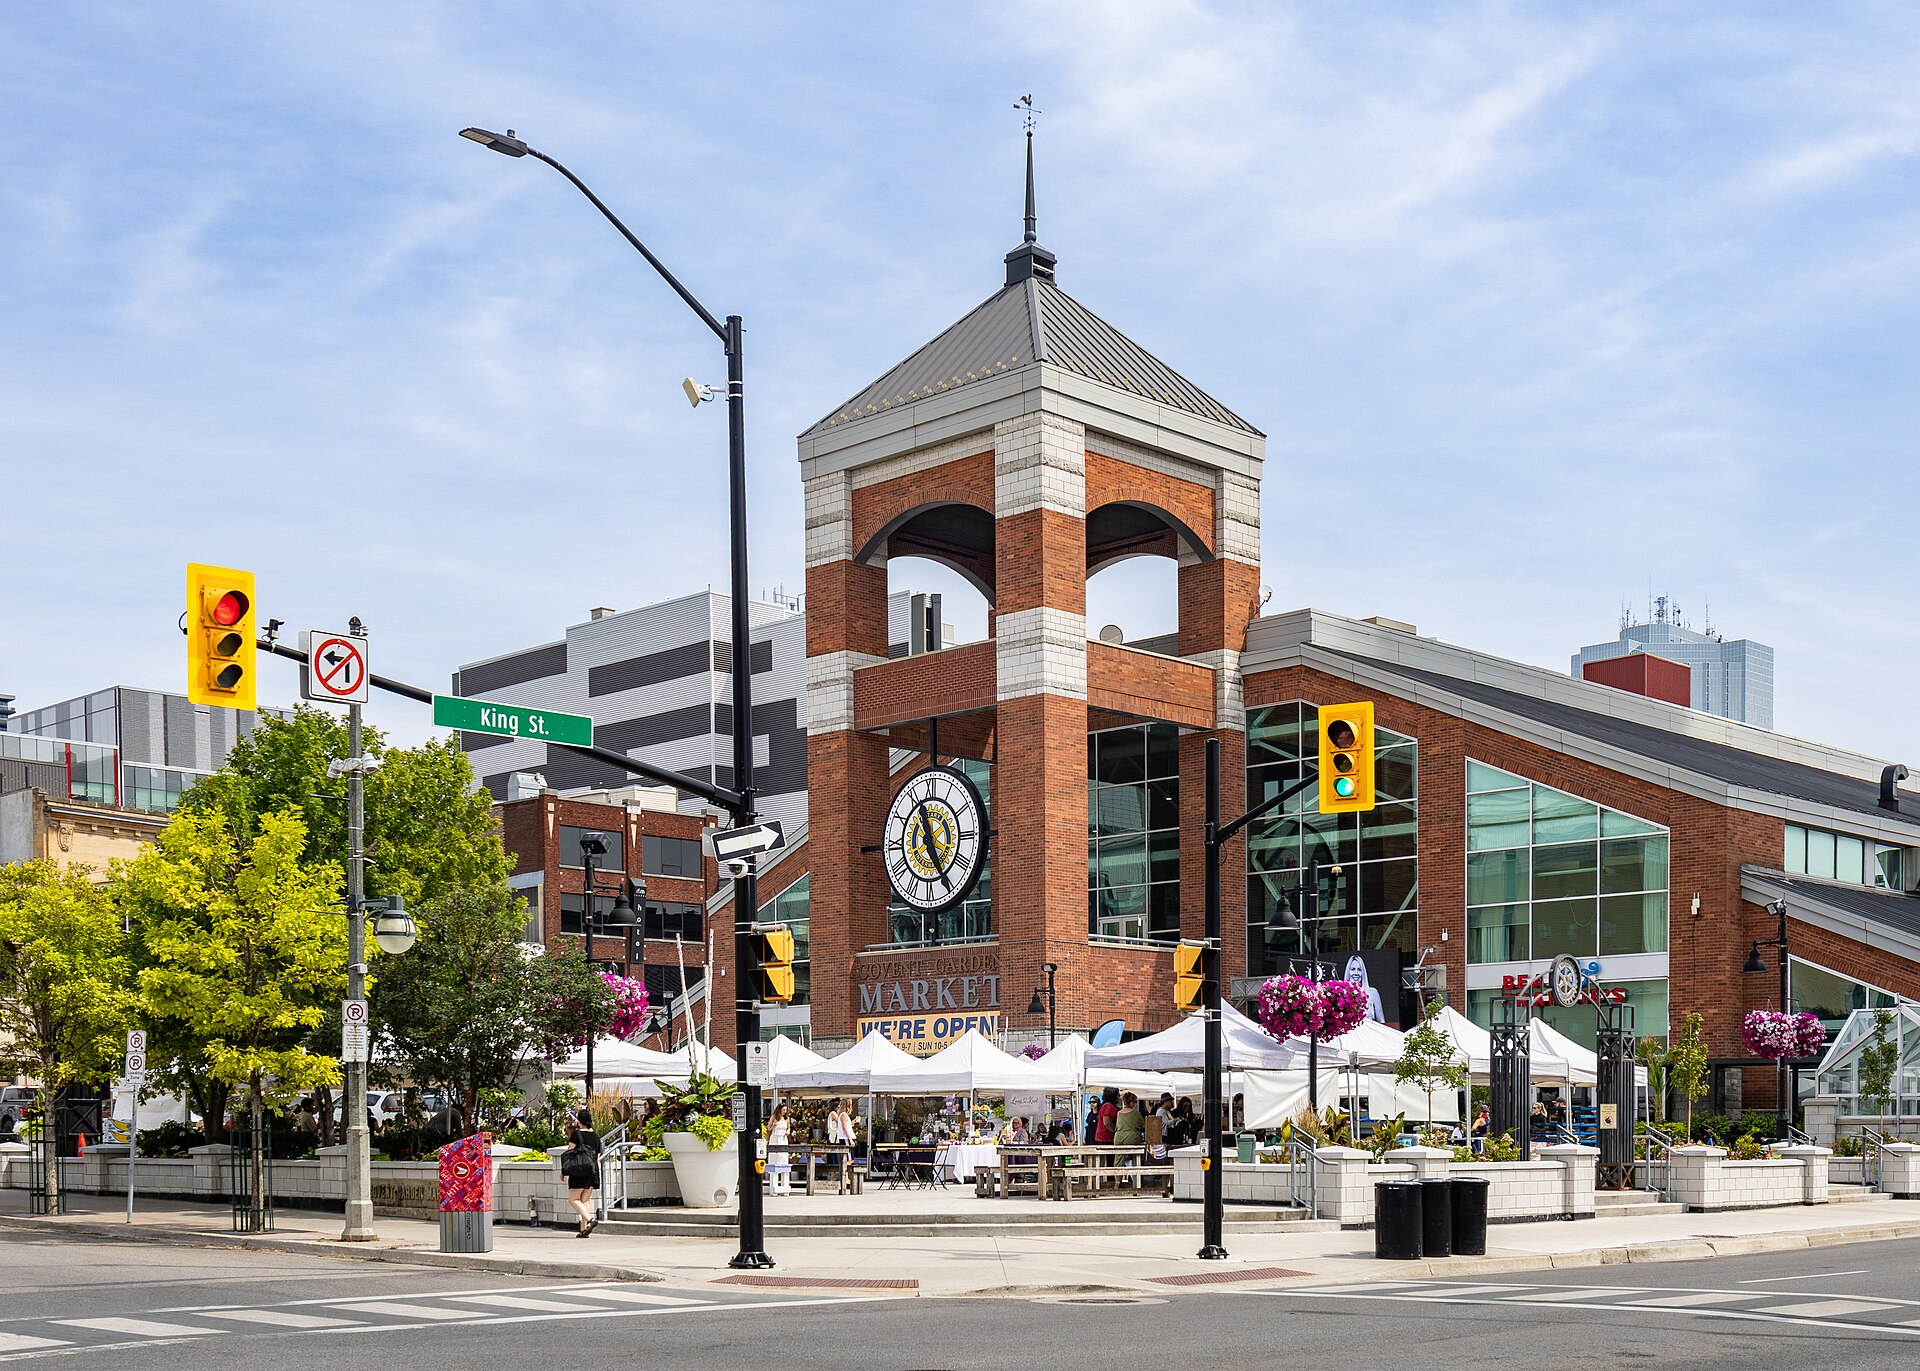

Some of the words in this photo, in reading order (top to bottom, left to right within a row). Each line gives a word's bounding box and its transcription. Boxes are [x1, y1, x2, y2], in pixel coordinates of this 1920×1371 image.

[480, 707, 519, 735] King
[528, 715, 549, 735] St.
[859, 959, 924, 980] COVENT
[934, 953, 1000, 975] GARDEN
[858, 975, 1000, 1014] MARKET
[918, 1041, 932, 1051] SUN
[934, 1041, 948, 1050] 10-5
